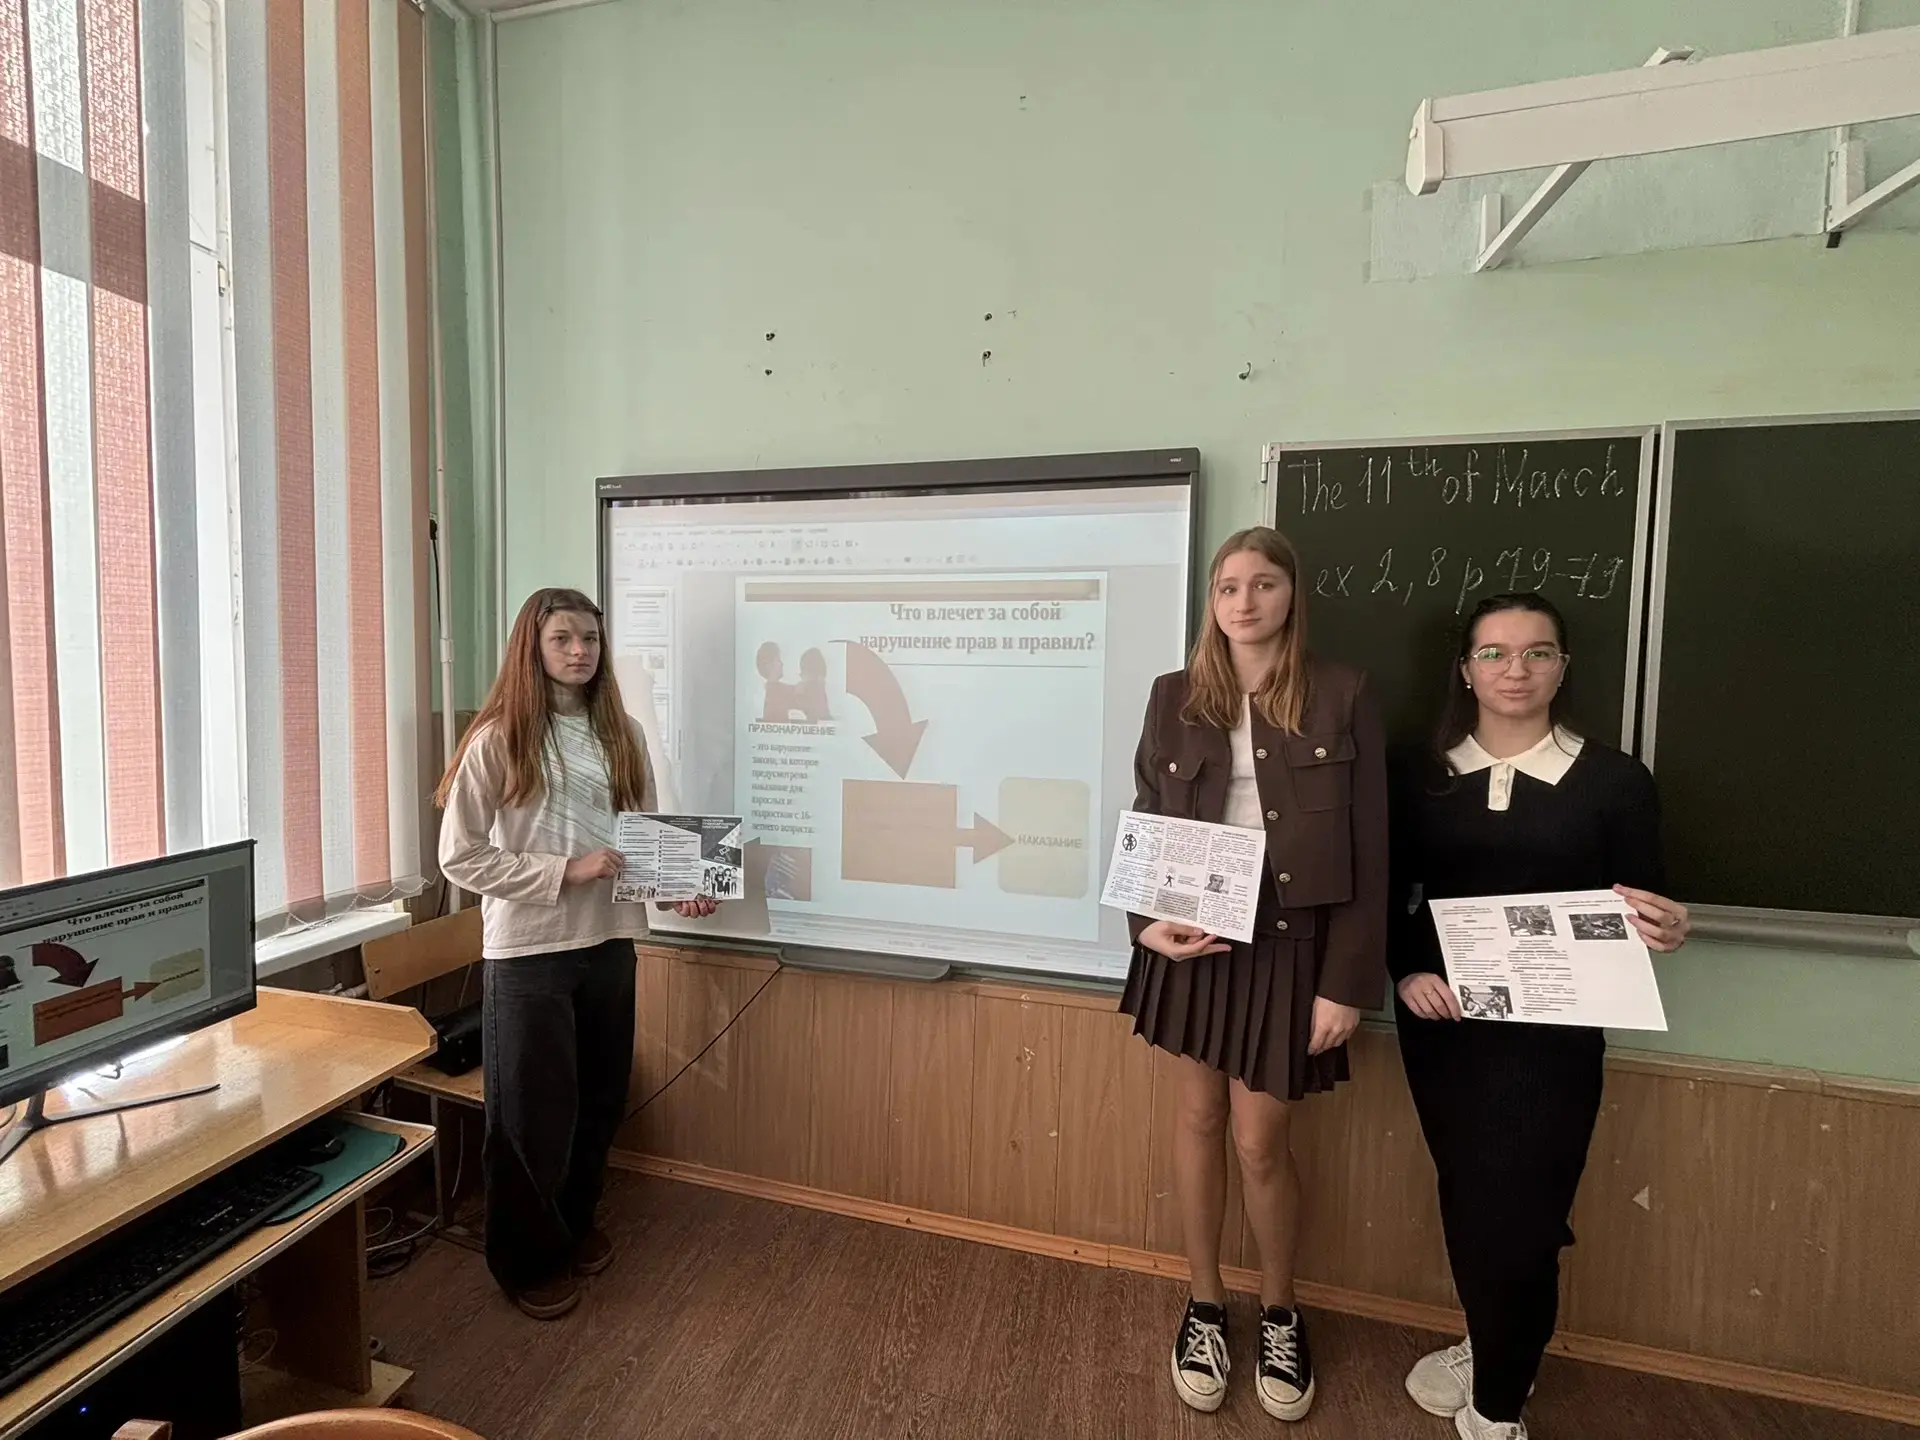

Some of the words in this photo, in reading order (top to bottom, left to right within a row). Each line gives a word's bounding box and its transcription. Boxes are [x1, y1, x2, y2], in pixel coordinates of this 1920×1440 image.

[1287, 456, 1347, 514] The
[1441, 449, 1481, 504] of
[1493, 443, 1624, 507] March
[1311, 564, 1354, 599] ex
[1454, 556, 1484, 615] p
[890, 603, 922, 621] Что
[926, 606, 985, 621] влечет
[988, 606, 1006, 620] за
[1011, 601, 1061, 621] собой
[860, 635, 952, 653] нарушение
[956, 636, 997, 653] прав
[1002, 636, 1013, 649] и
[1018, 632, 1095, 654] правил?
[748, 723, 836, 736] ПРАВОНАРУШЕНИЕ
[1018, 834, 1083, 849] НАКАЗАНИЕ
[42, 921, 115, 944] нарушение
[117, 912, 146, 926] прав
[148, 909, 157, 918] и
[158, 897, 205, 914] правил?
[67, 915, 92, 927] Что
[95, 905, 136, 919] влечет
[138, 902, 150, 910] за
[152, 892, 185, 905] собой
